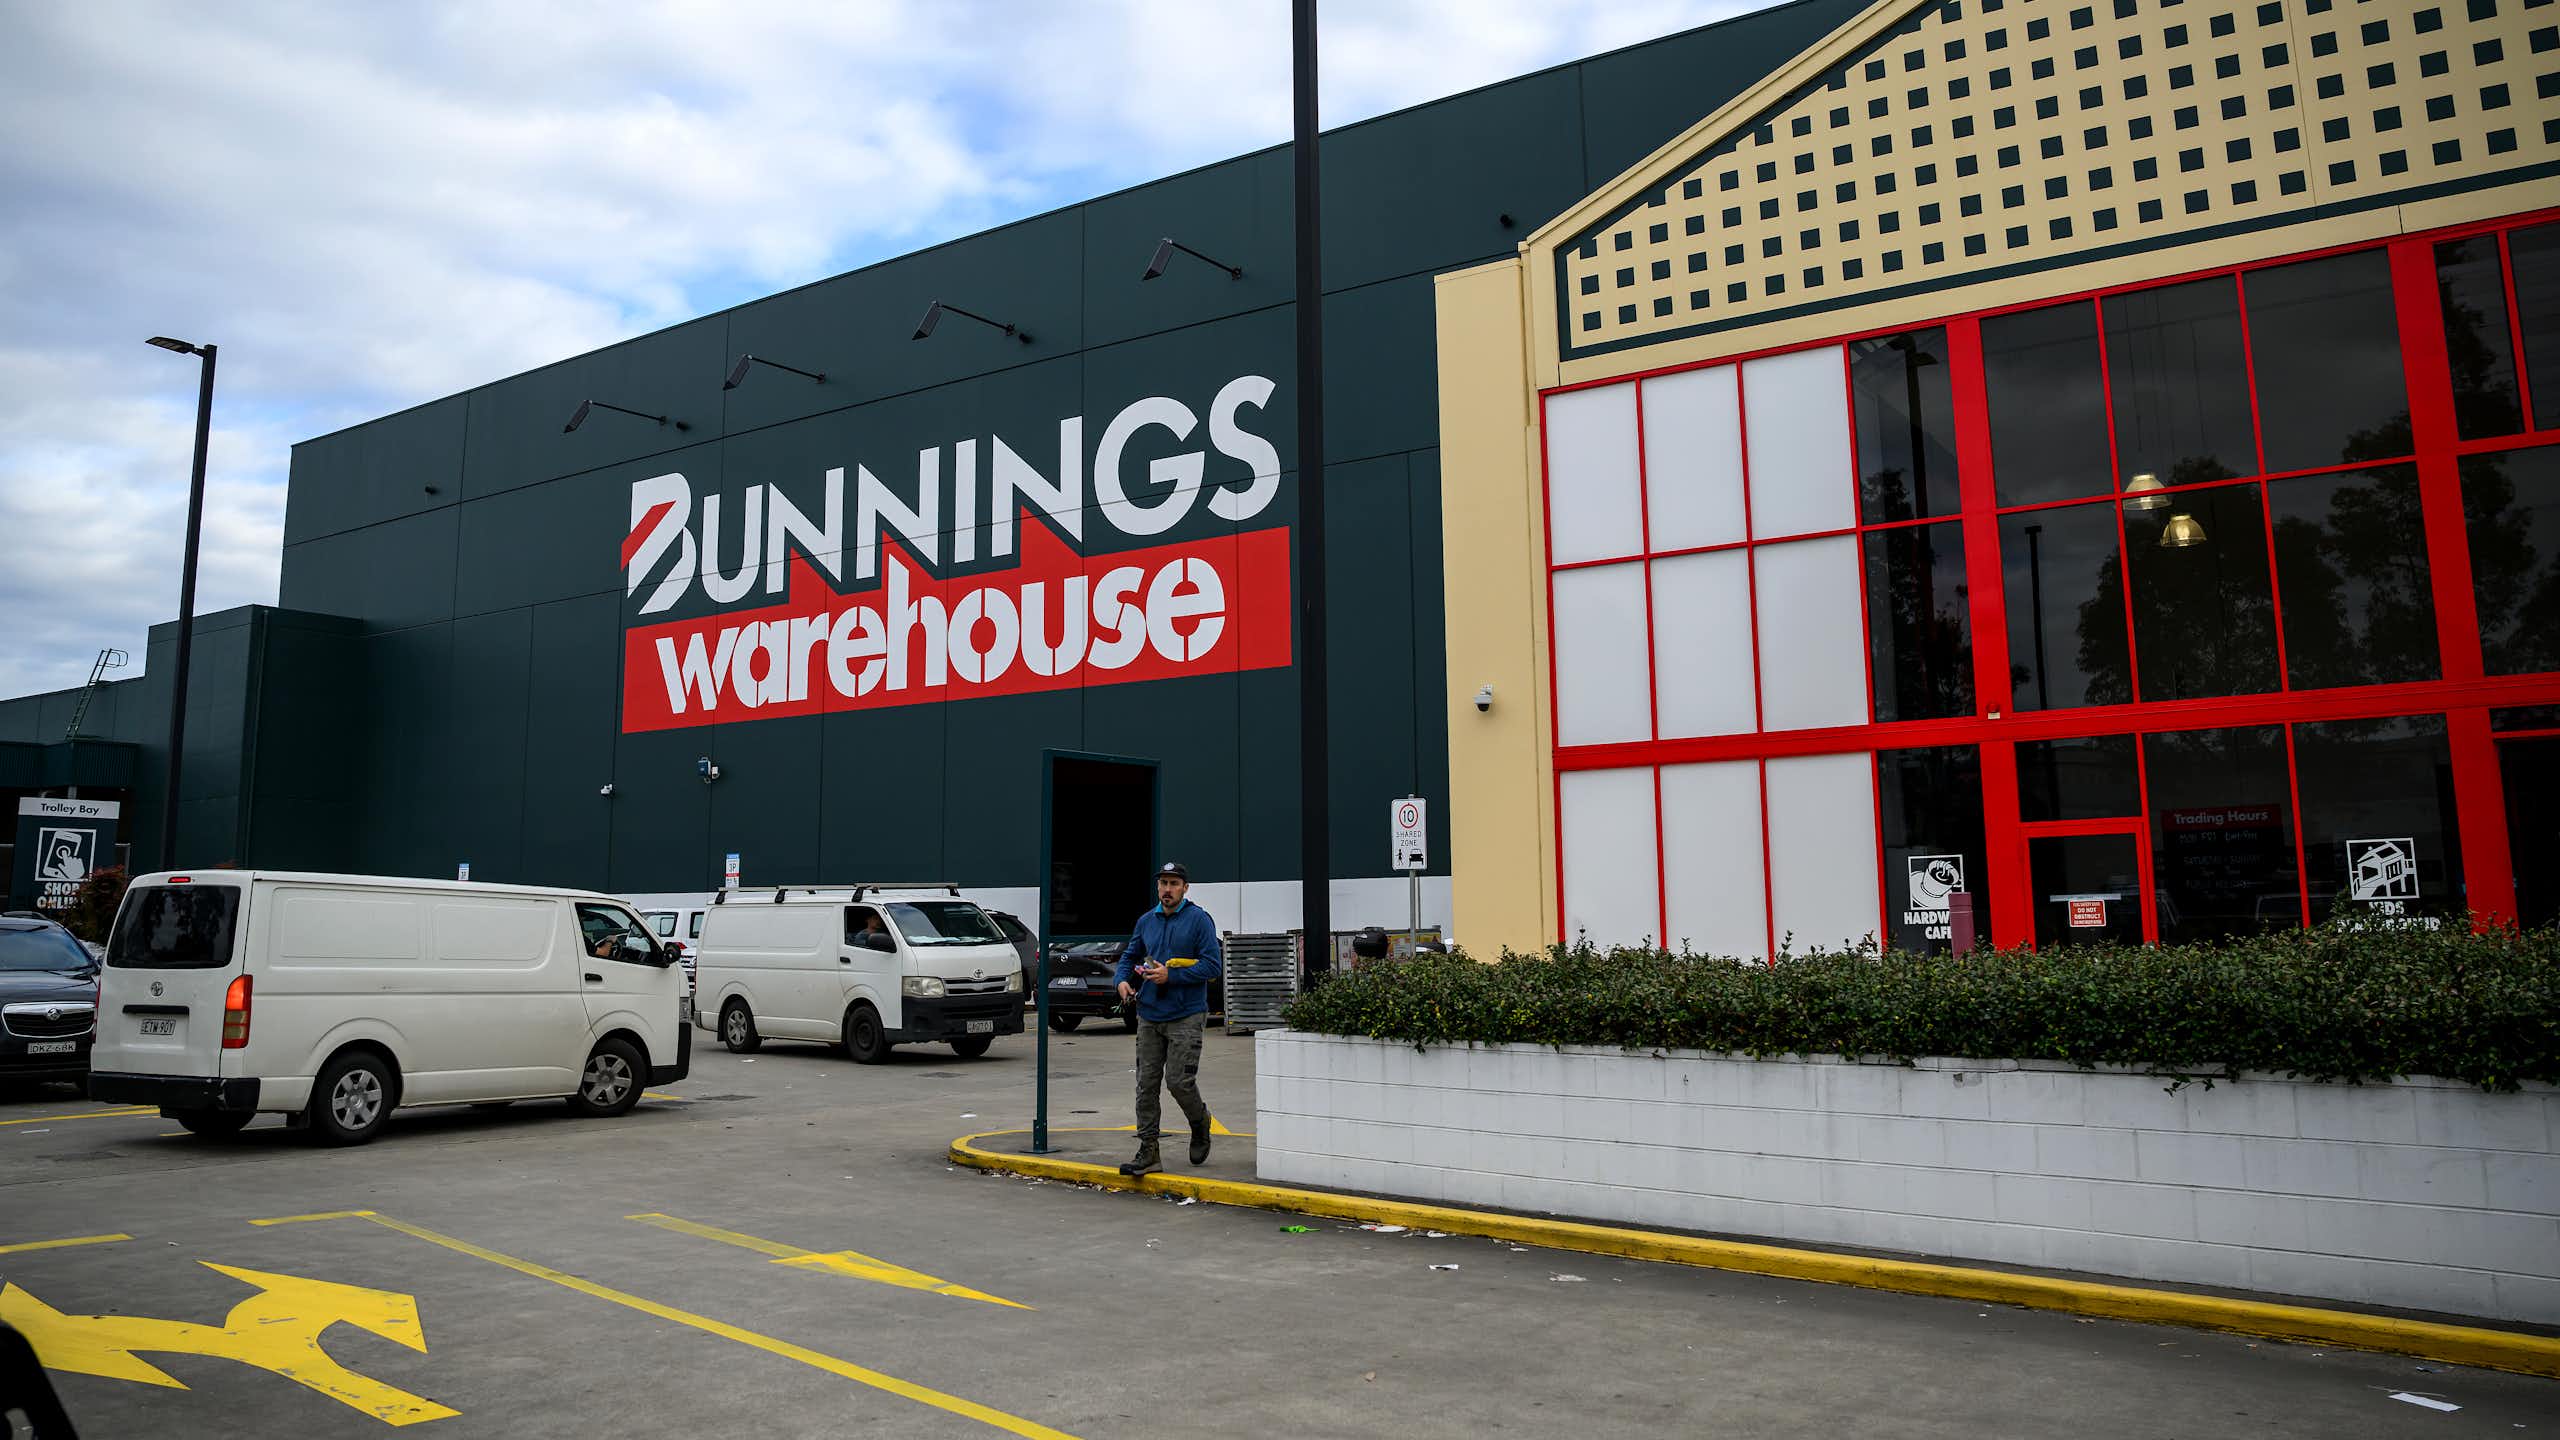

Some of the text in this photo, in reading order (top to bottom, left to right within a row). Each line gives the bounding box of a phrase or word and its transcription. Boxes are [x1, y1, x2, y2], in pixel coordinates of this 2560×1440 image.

[622, 375, 1281, 614] BUNNINGS
[655, 553, 1226, 715] warehouse
[41, 803, 100, 816] Trolley Bay
[1403, 810, 1415, 822] 10
[2174, 810, 2269, 825] Trading Hours
[1396, 830, 1422, 838] SHARED
[1401, 839, 1417, 847] ZONE
[44, 882, 80, 896] SHOP
[1903, 910, 1950, 925] HARDW
